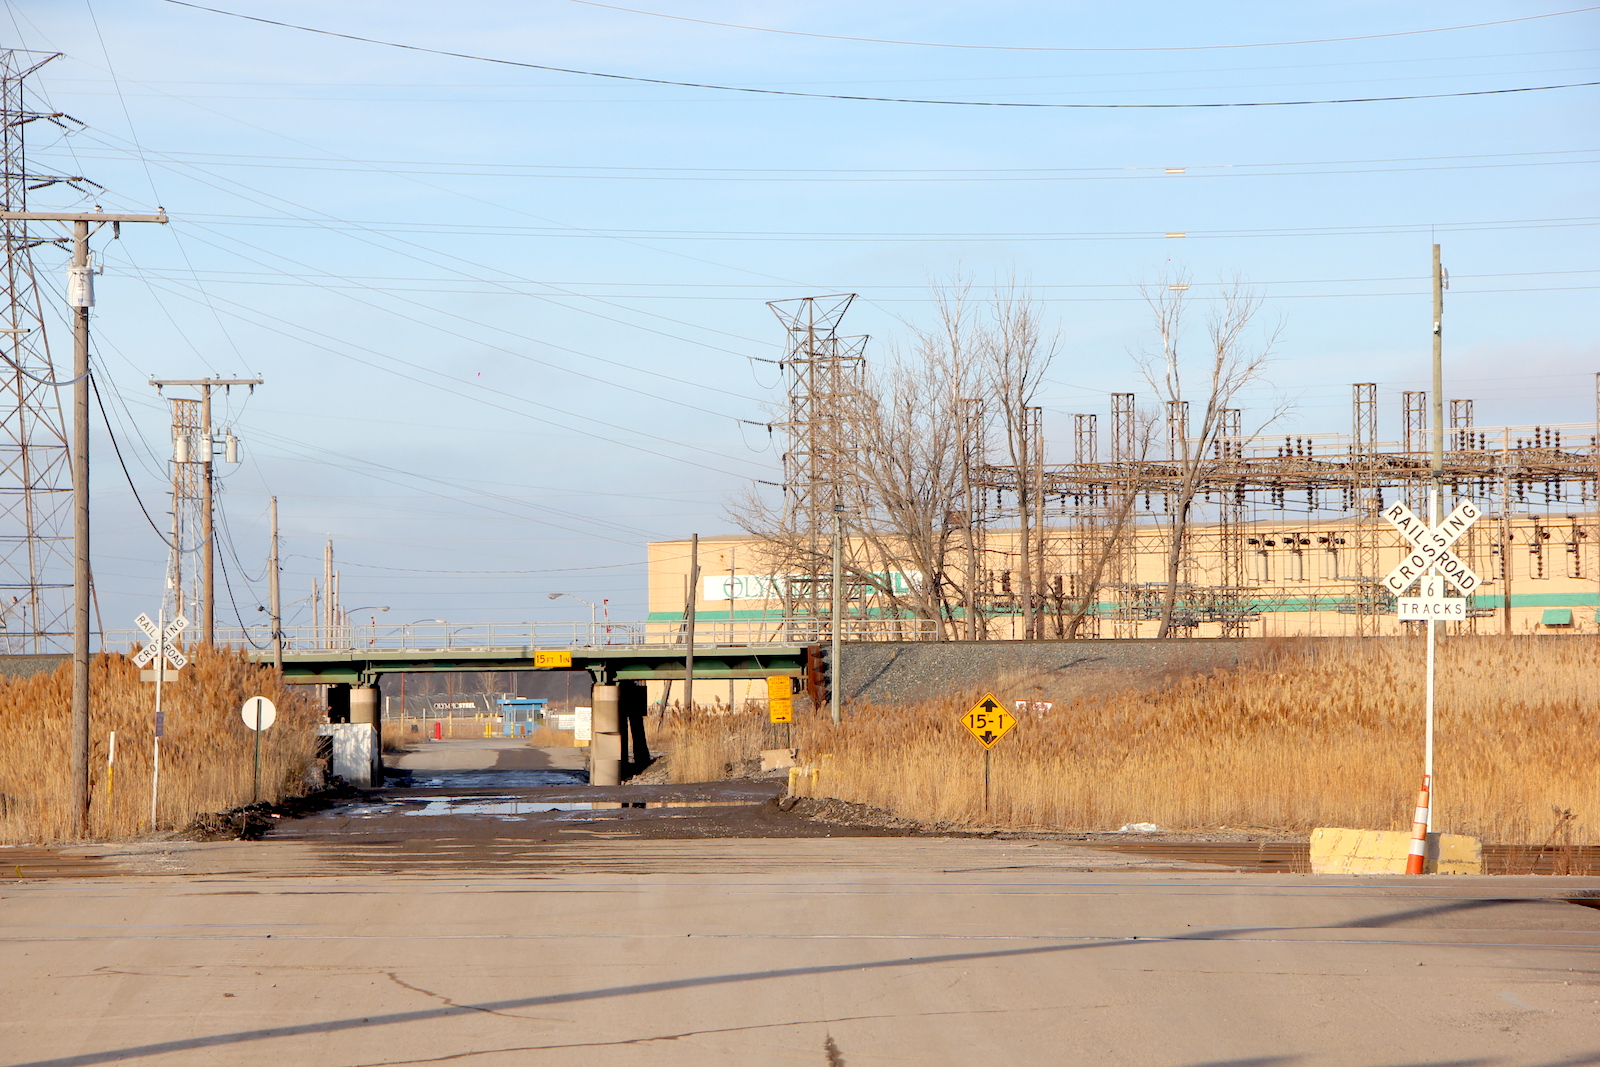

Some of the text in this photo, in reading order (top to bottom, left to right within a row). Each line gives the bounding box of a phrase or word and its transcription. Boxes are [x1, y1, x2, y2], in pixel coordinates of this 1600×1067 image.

[1389, 505, 1476, 590] CROSSING
[1427, 582, 1434, 597] 6
[1401, 603, 1462, 614] TRACKS
[536, 654, 546, 664] 15
